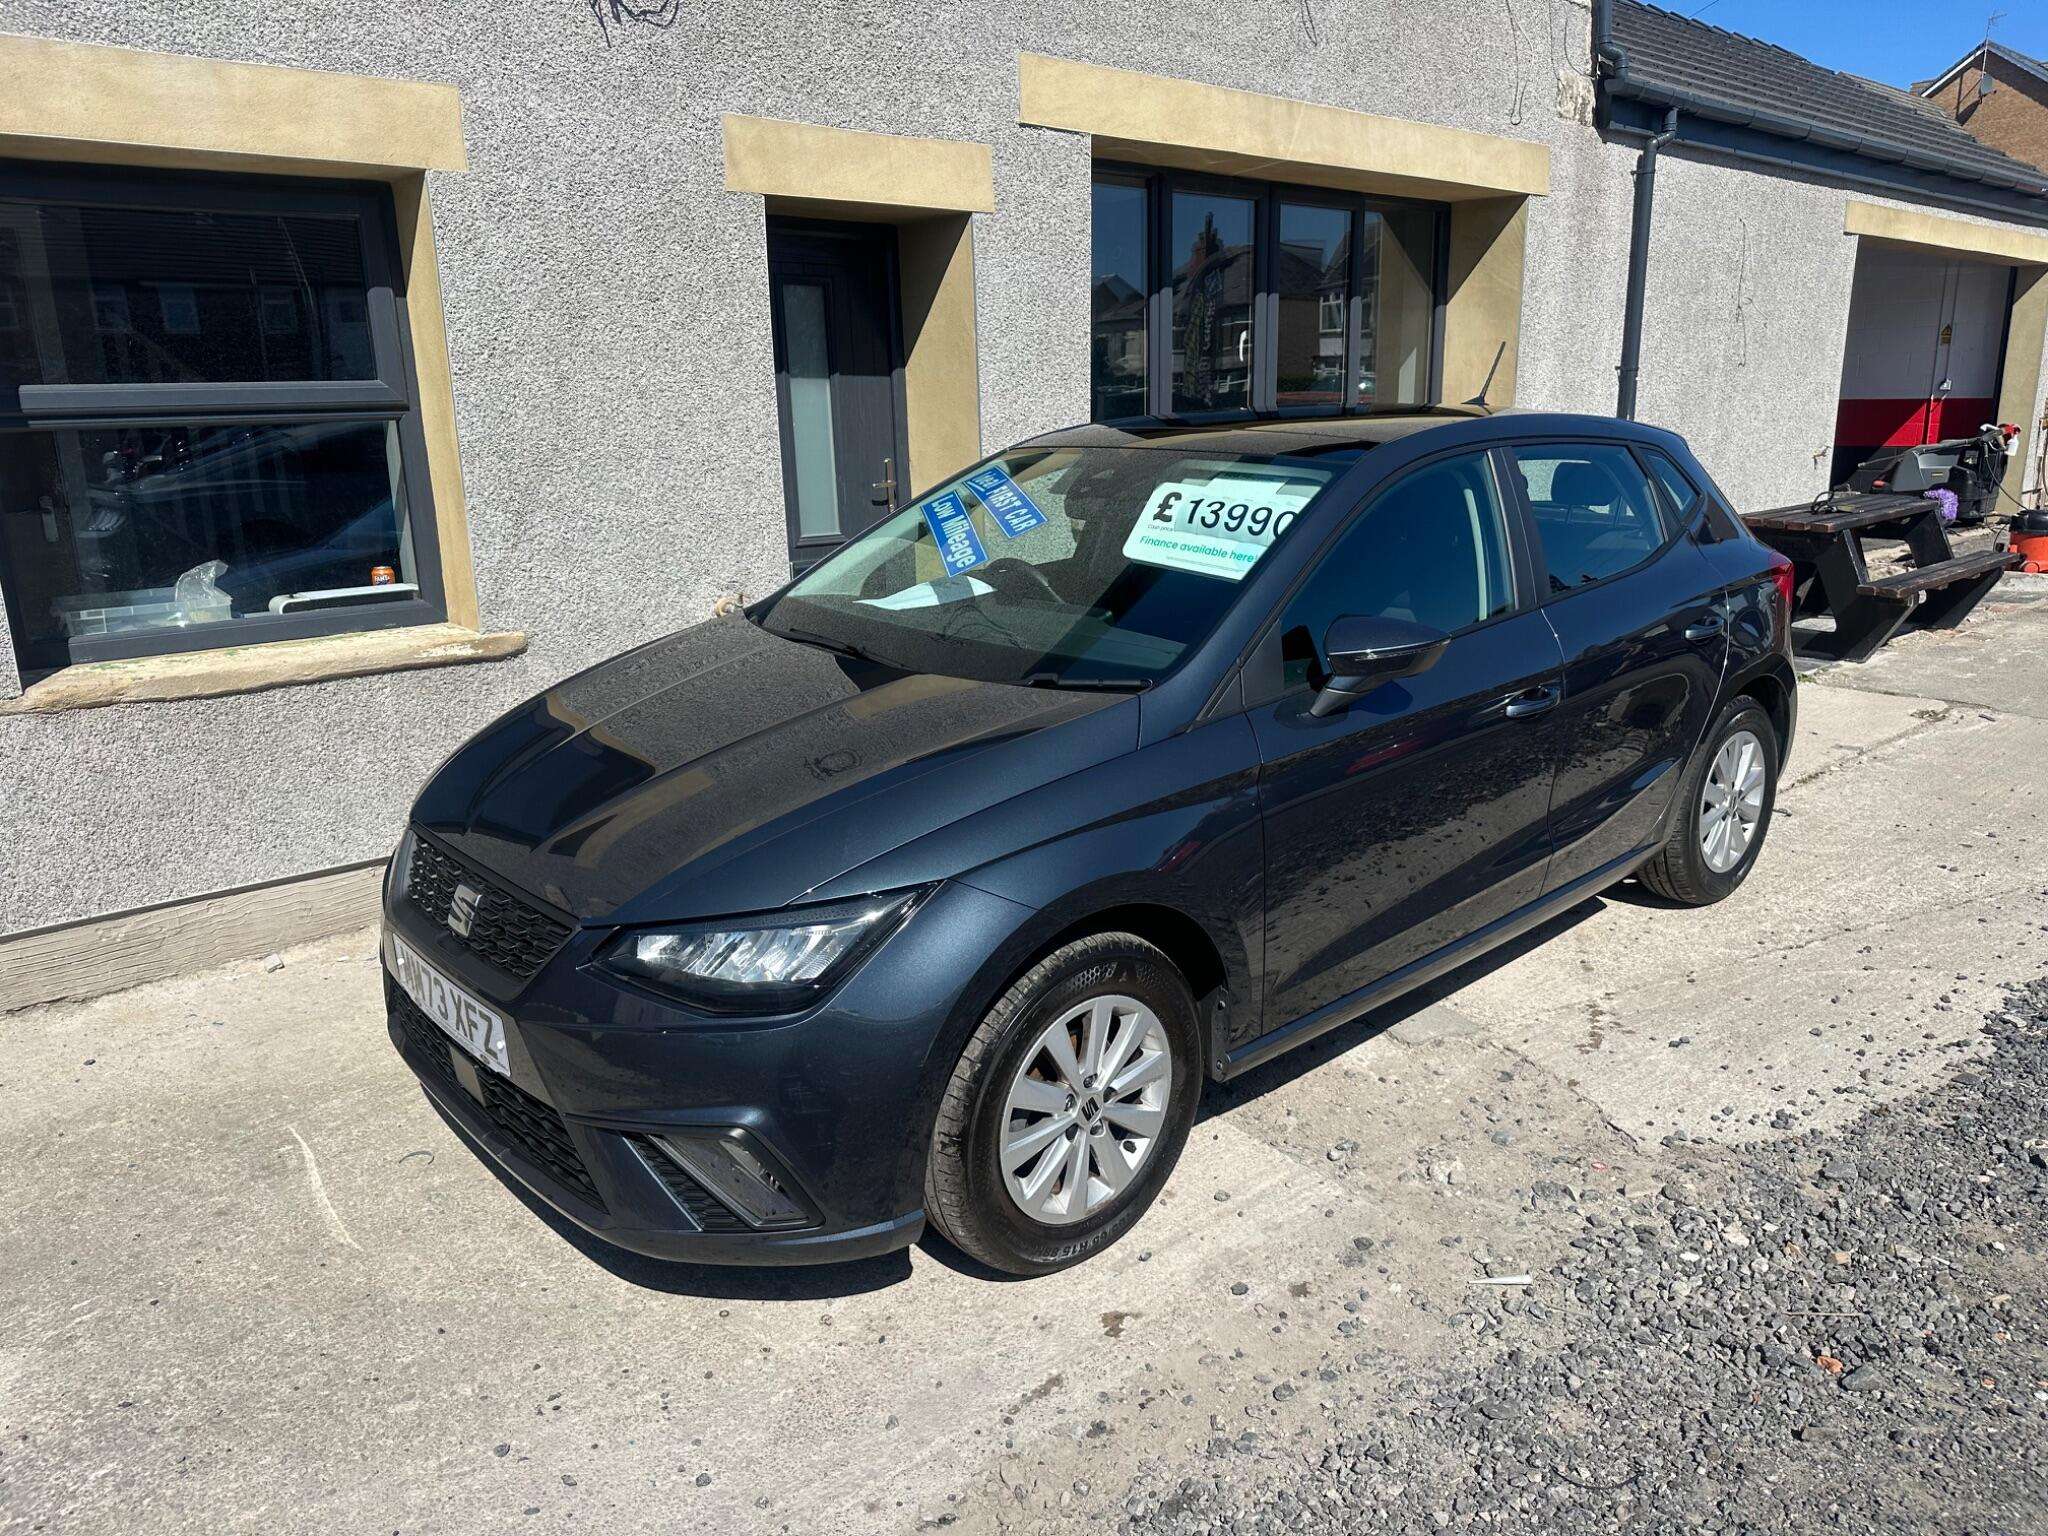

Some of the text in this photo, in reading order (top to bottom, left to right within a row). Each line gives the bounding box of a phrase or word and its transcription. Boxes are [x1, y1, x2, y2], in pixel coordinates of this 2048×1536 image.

[986, 486, 1022, 512] FIRST
[1004, 508, 1037, 532] CAR
[941, 515, 976, 568] Mileage
[1139, 535, 1178, 549] Finance
[1179, 542, 1228, 558] available
[449, 987, 498, 1060] XFZ
